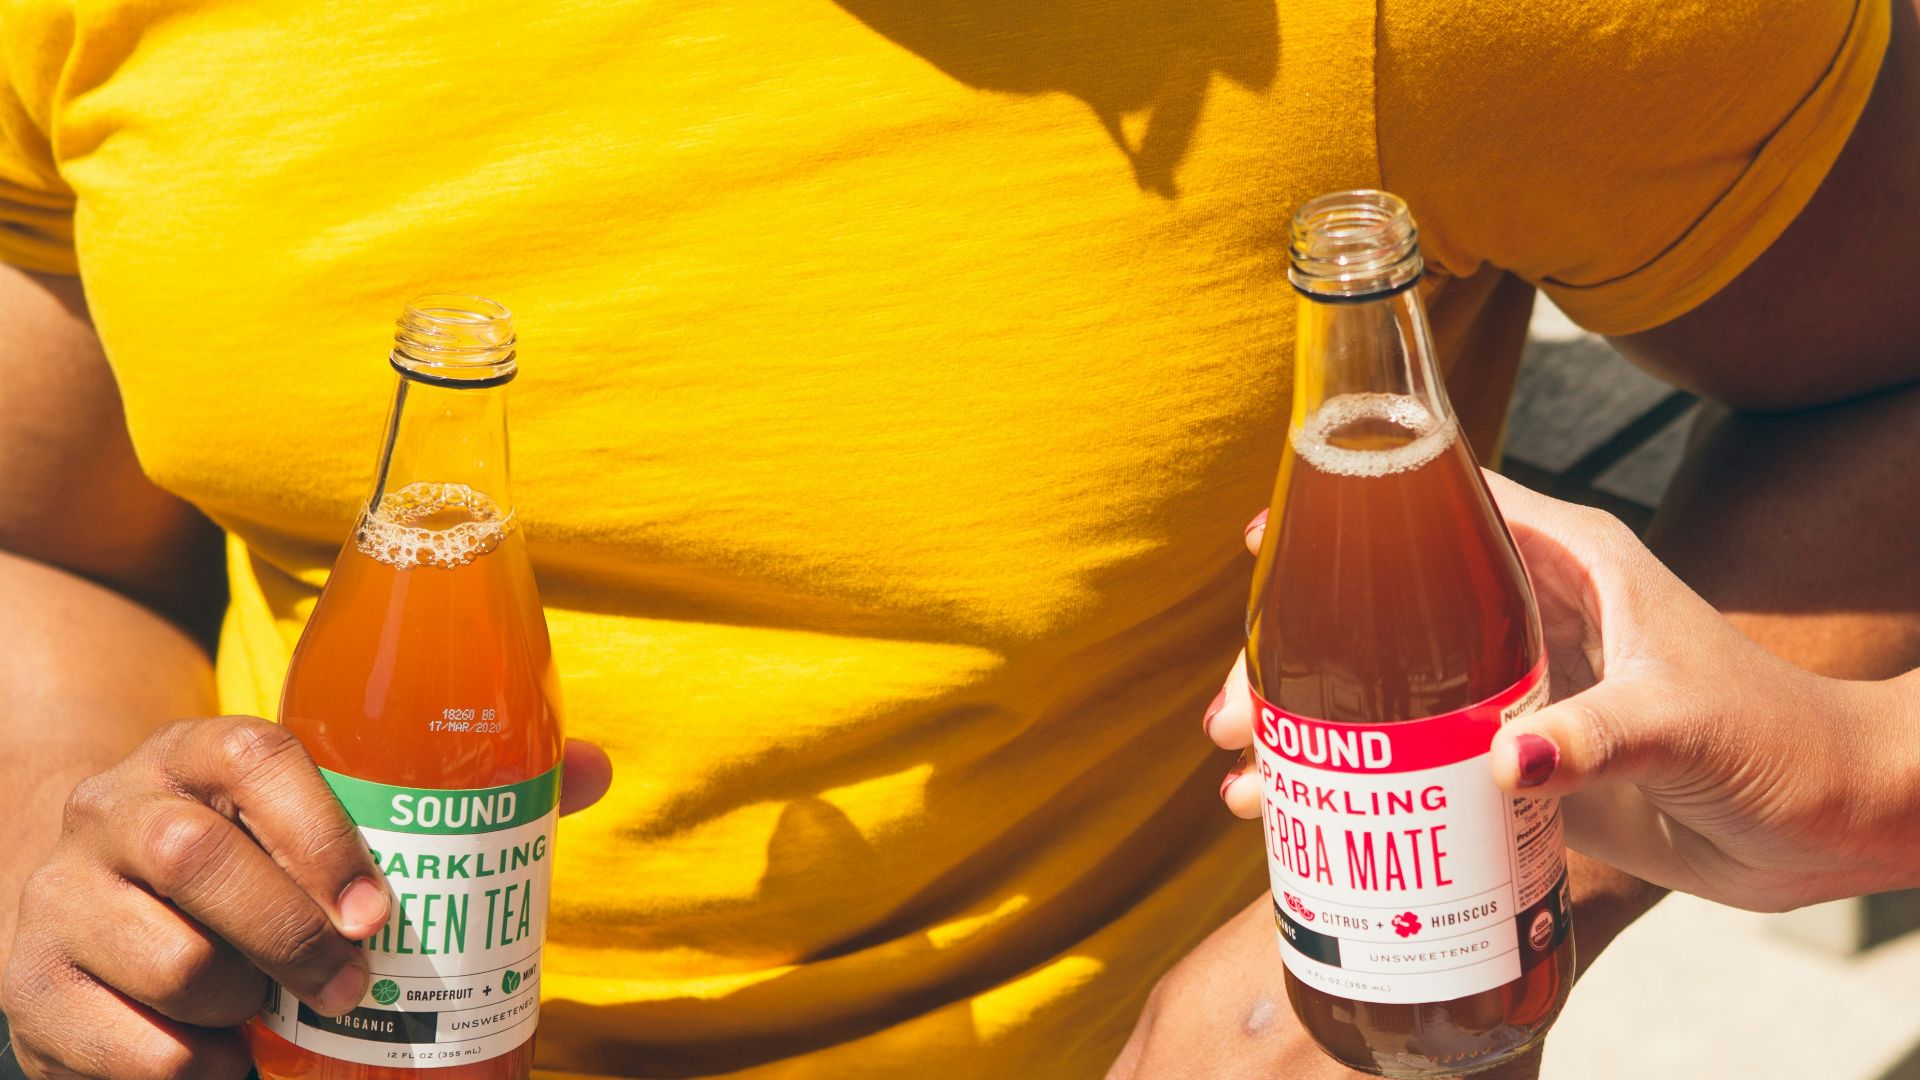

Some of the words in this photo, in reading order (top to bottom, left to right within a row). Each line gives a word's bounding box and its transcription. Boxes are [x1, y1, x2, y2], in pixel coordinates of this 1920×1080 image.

[429, 720, 502, 733] 17/MAR/2020
[442, 708, 475, 720] 18260
[482, 708, 496, 720] BB
[1261, 707, 1393, 769] SOUND
[390, 791, 517, 828] SOUND
[1263, 795, 1334, 887] ERBA
[1345, 824, 1453, 892] MATE
[485, 879, 531, 950] TEA
[1322, 911, 1369, 930] CITRUS
[1431, 901, 1498, 928] HIBISCUS
[1369, 940, 1490, 963] UNSWEETENED
[406, 988, 473, 1002] GRAPEFRUIT
[522, 963, 537, 982] MINT
[451, 997, 534, 1031] UNSWEETENED
[438, 1050, 461, 1060] (355
[464, 1046, 482, 1056] mL)
